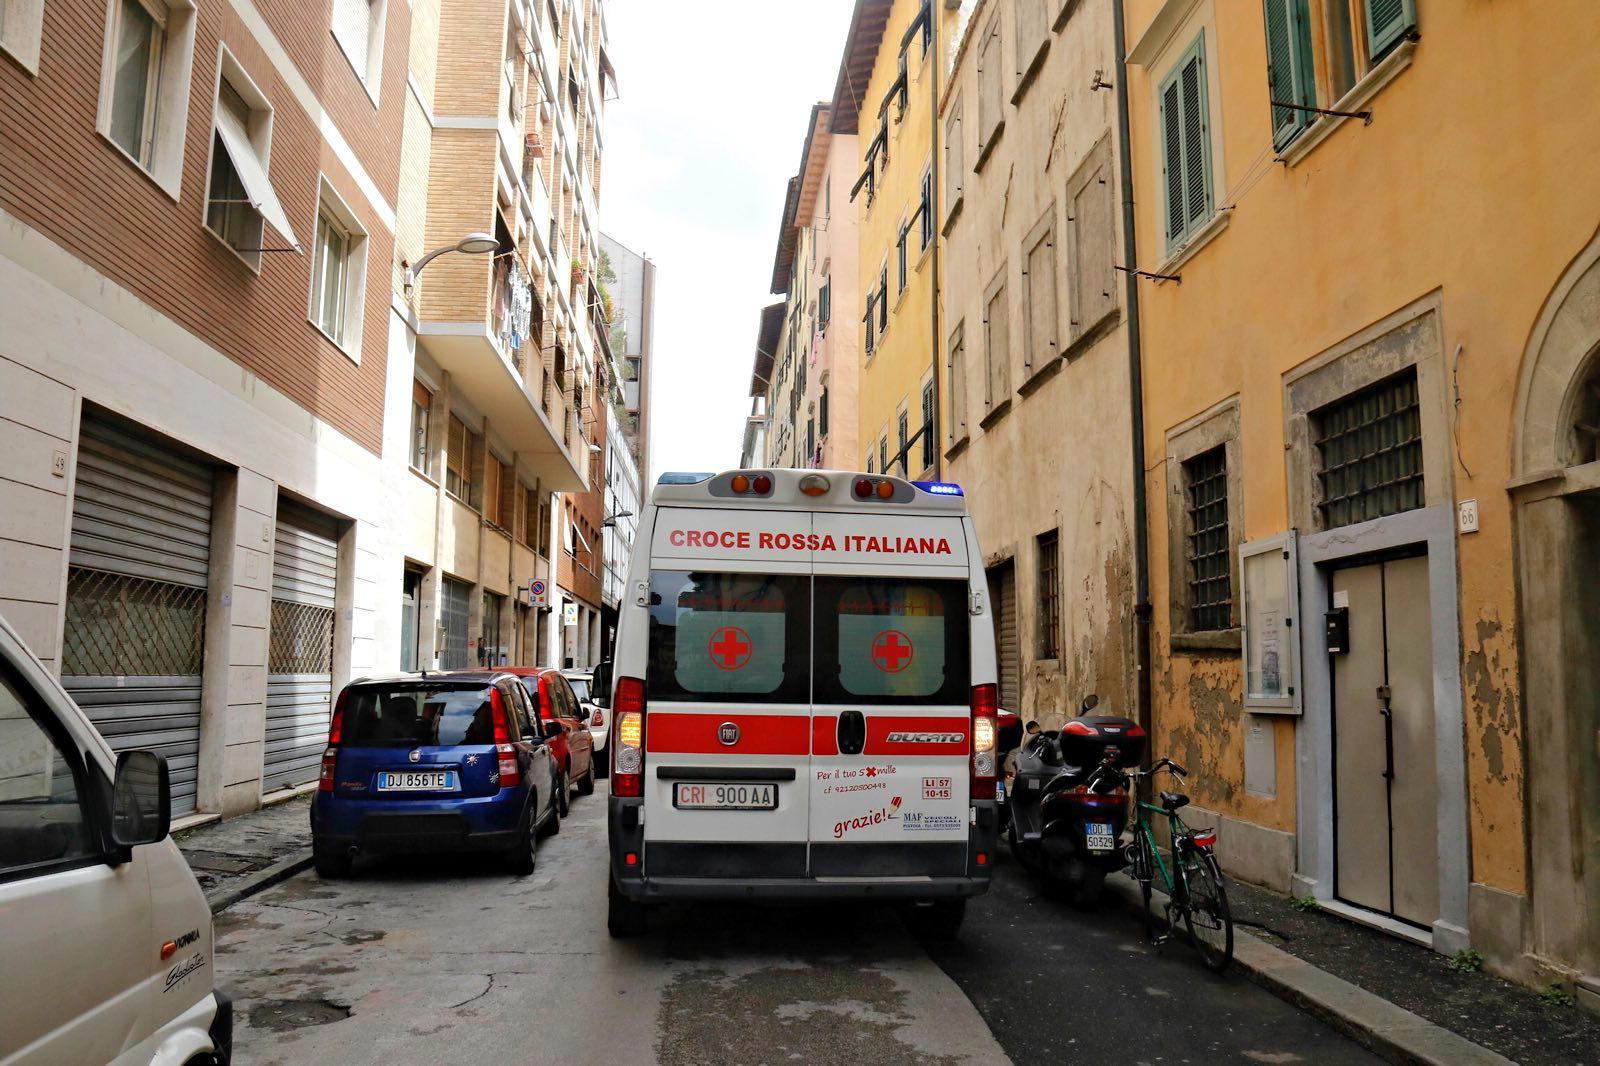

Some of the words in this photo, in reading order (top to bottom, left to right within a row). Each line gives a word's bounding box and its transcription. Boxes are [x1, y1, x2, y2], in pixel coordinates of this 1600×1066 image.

[1462, 508, 1474, 525] 66
[670, 530, 751, 548] CROCE
[759, 533, 837, 551] ROSSA
[845, 535, 952, 554] ITALIANA
[722, 729, 736, 739] FIAT
[887, 732, 964, 743] DUCATO
[817, 771, 832, 780] Per
[834, 769, 840, 779] il
[843, 769, 857, 778] tuo
[877, 764, 897, 775] mille
[387, 774, 403, 787] DJ
[926, 779, 935, 787] LI
[939, 779, 949, 787] 57
[680, 786, 705, 804] CRI
[716, 787, 747, 804] 900
[751, 787, 771, 804] AA
[925, 790, 949, 798] 10-15
[903, 812, 923, 821] MAF
[834, 808, 886, 838] grazie!
[1088, 836, 1114, 848] 50329
